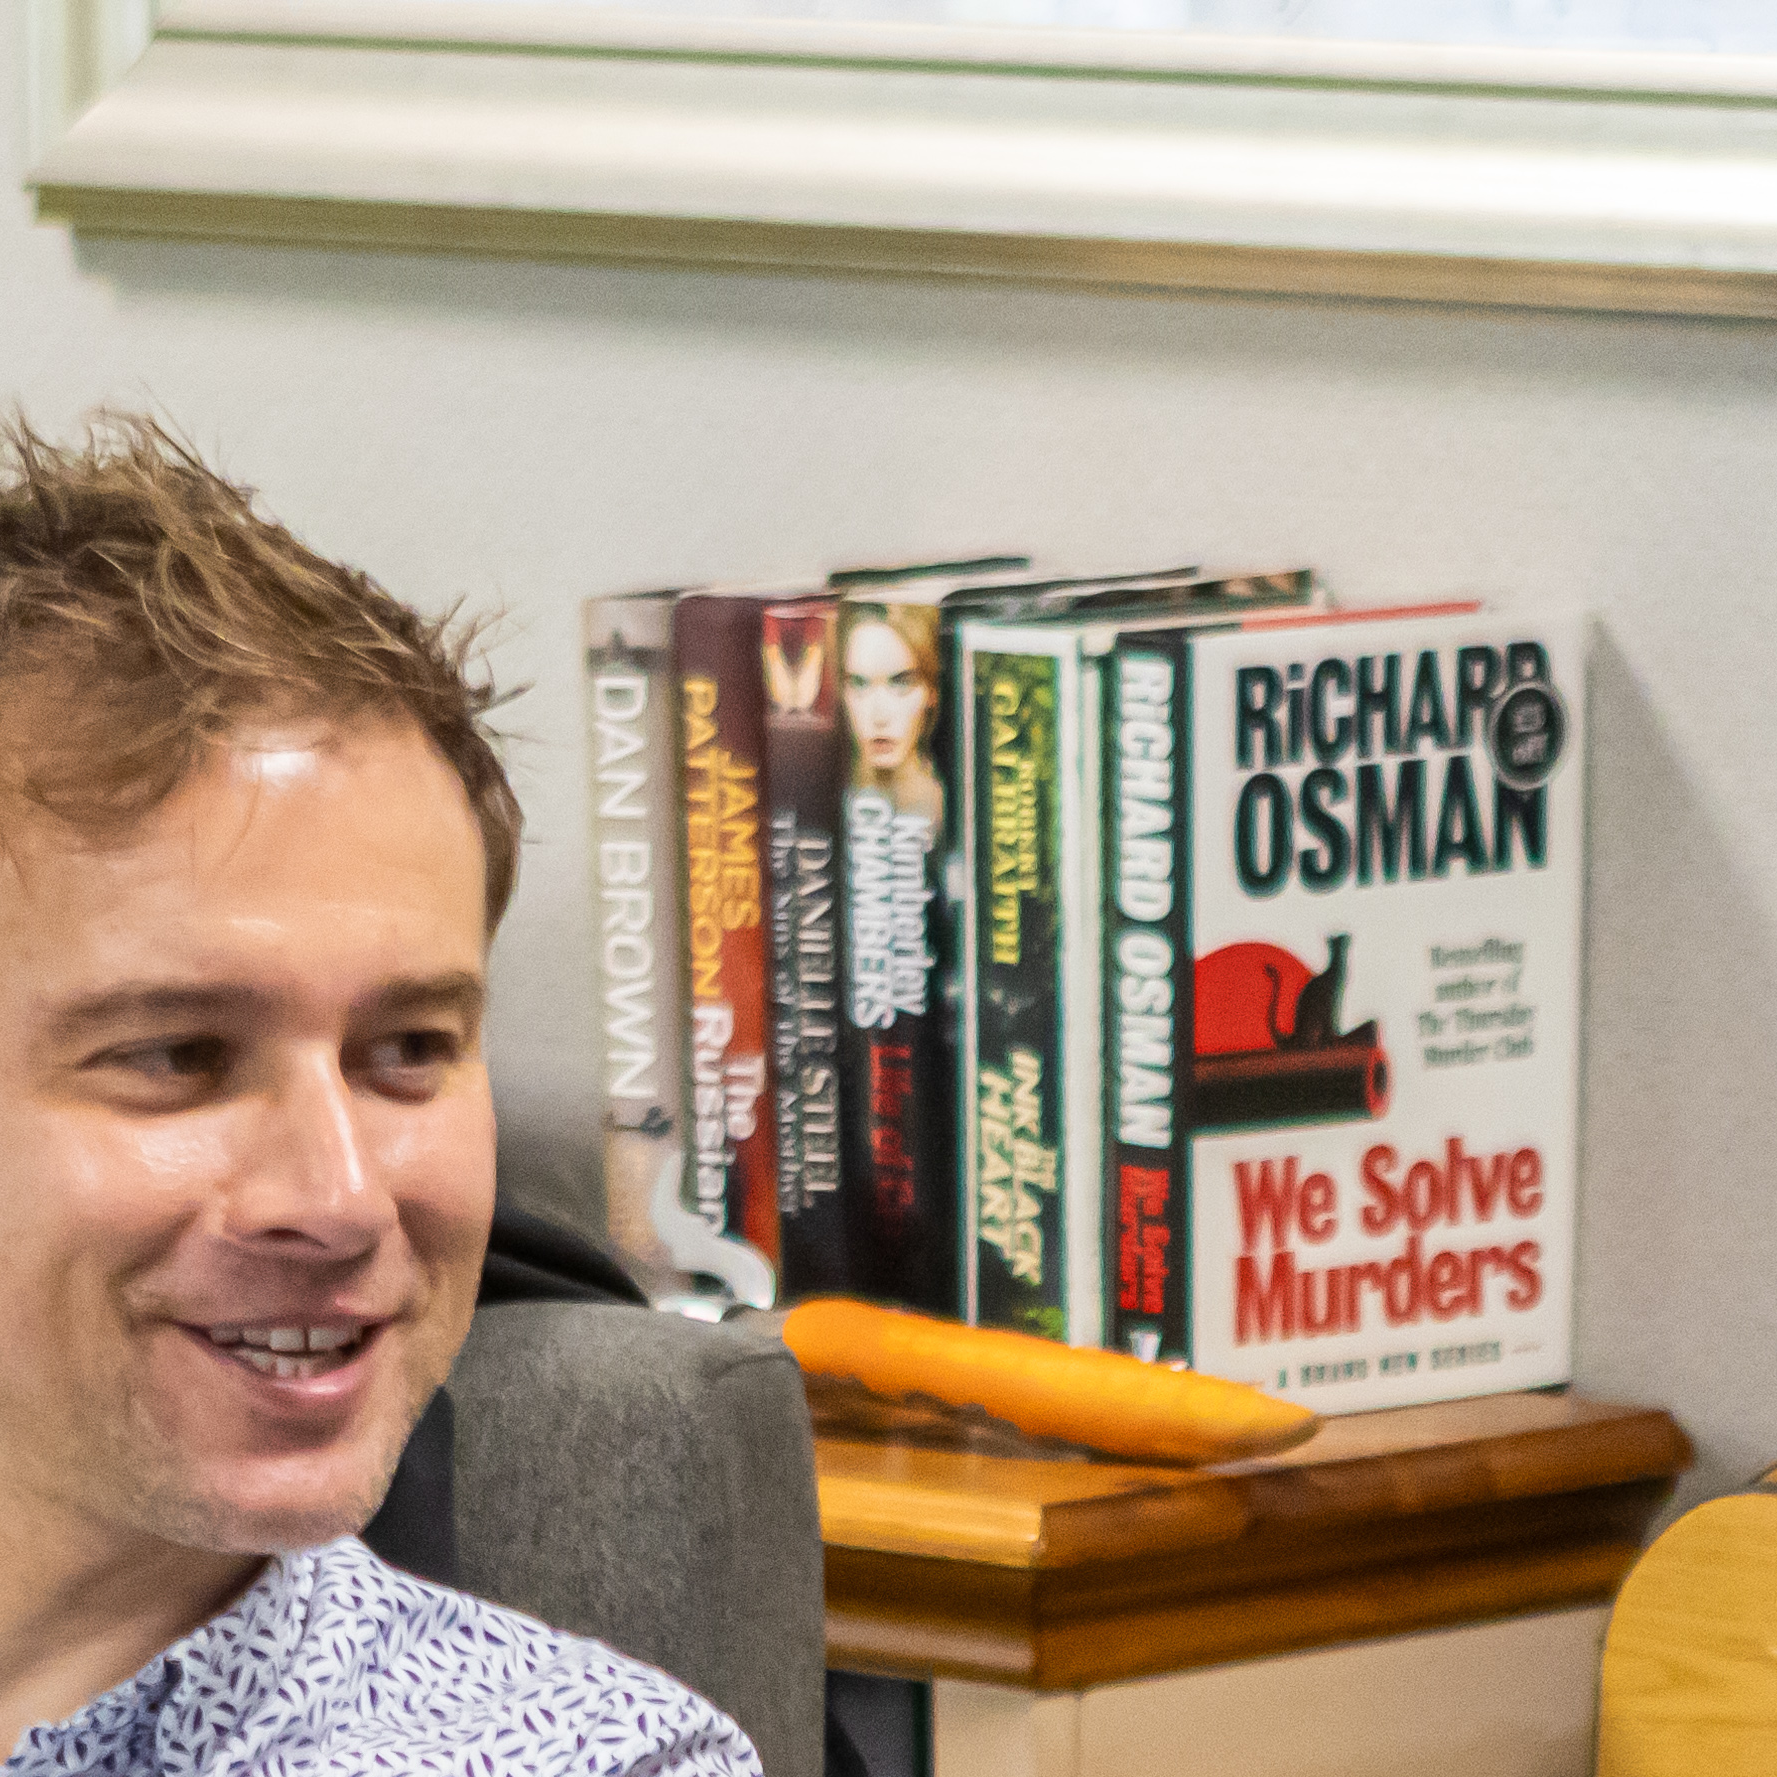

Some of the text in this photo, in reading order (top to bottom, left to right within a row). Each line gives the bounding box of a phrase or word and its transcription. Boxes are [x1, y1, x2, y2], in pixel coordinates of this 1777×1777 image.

[594, 675, 650, 820] DAN
[685, 679, 725, 1003] PATTERSON
[723, 750, 763, 931] JAMES
[991, 680, 1021, 965] GALBRAITH
[1233, 753, 1549, 899] OSMAN
[599, 840, 657, 1099] BROWN
[851, 793, 895, 1030] CHAMBERS
[892, 812, 937, 1017] Kimberley
[725, 1052, 766, 1141] The
[796, 836, 840, 1208] DANIELLE STEEL
[1119, 930, 1174, 1149] OSMAN
[980, 1068, 1013, 1261] HEART
[1011, 1050, 1045, 1287] INK BLACK
[1232, 1135, 1545, 1251] We Solve
[1232, 1233, 1544, 1349] Murders
[1299, 1357, 1369, 1388] BRAND
[1378, 1350, 1420, 1378] NEW
[1430, 1340, 1504, 1372] SERIES
